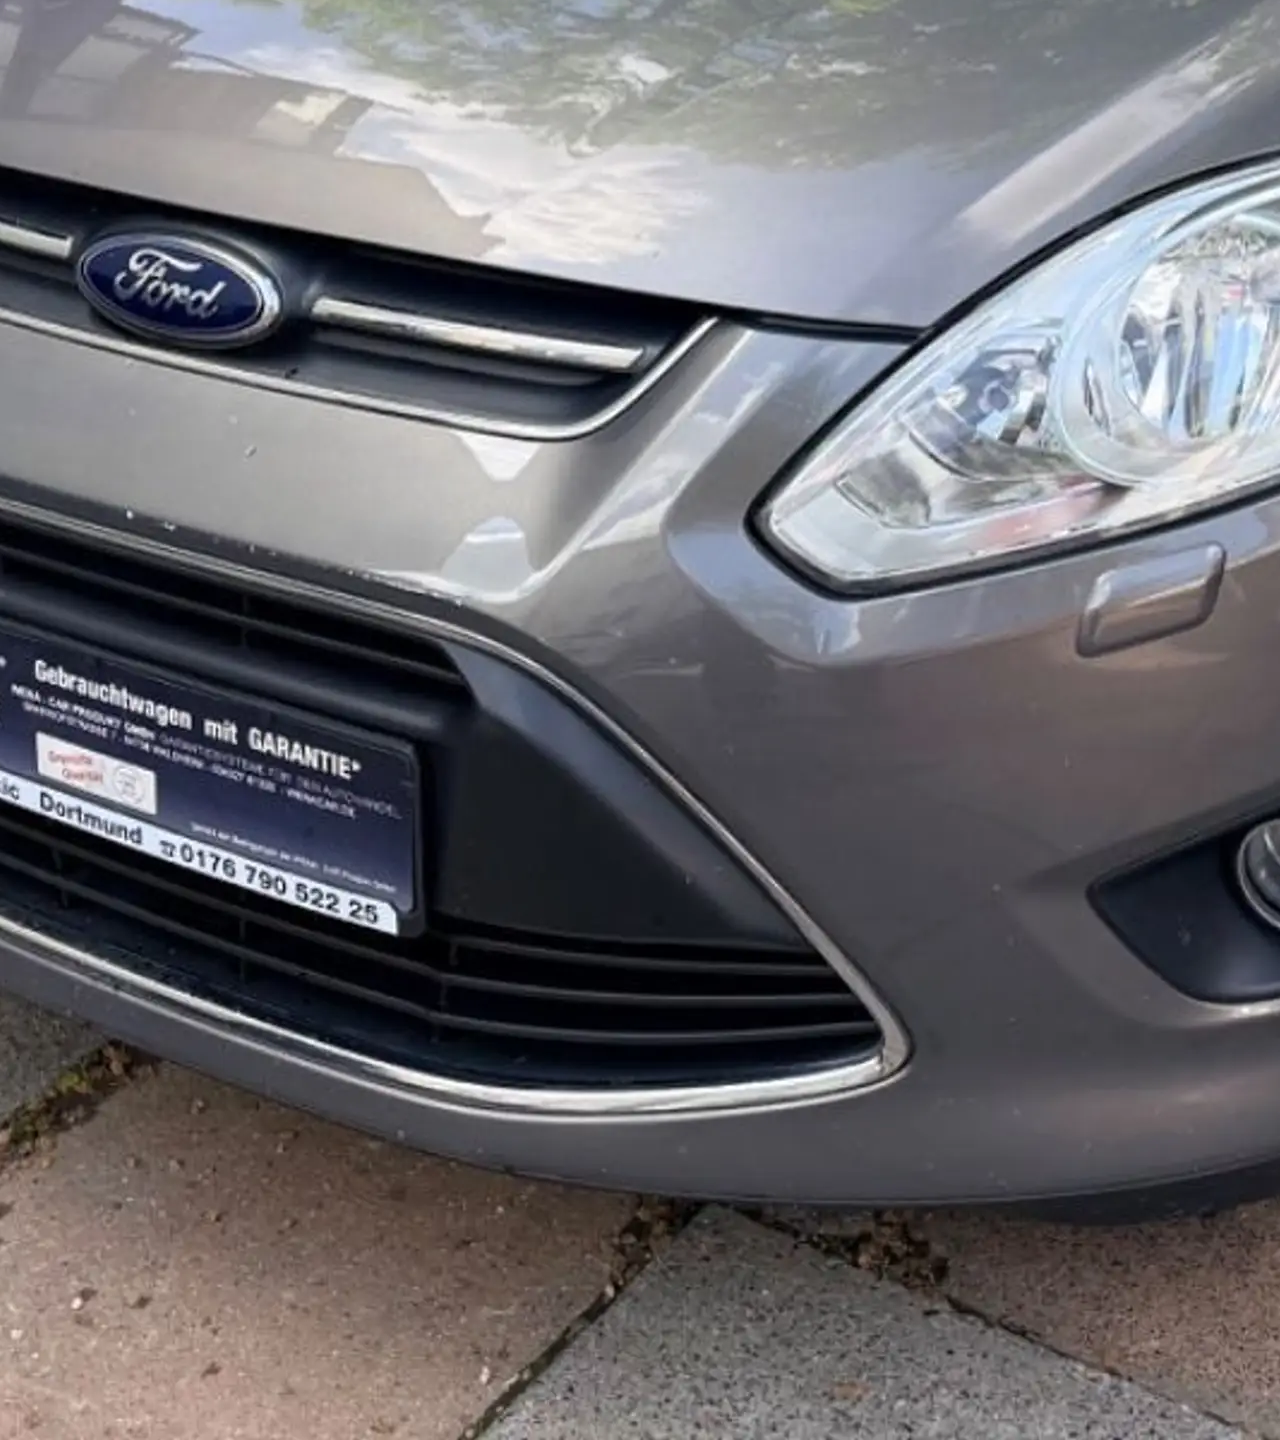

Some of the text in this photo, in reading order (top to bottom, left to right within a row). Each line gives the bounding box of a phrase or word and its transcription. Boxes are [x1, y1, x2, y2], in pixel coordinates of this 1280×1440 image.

[114, 247, 227, 319] Ford
[35, 659, 192, 732] Gebrauchtwagen
[203, 717, 238, 747] mit
[39, 791, 144, 846] Dortmund
[179, 843, 237, 879] 0176
[244, 863, 287, 897] 790
[294, 882, 341, 914] 522
[347, 898, 379, 925] 25
